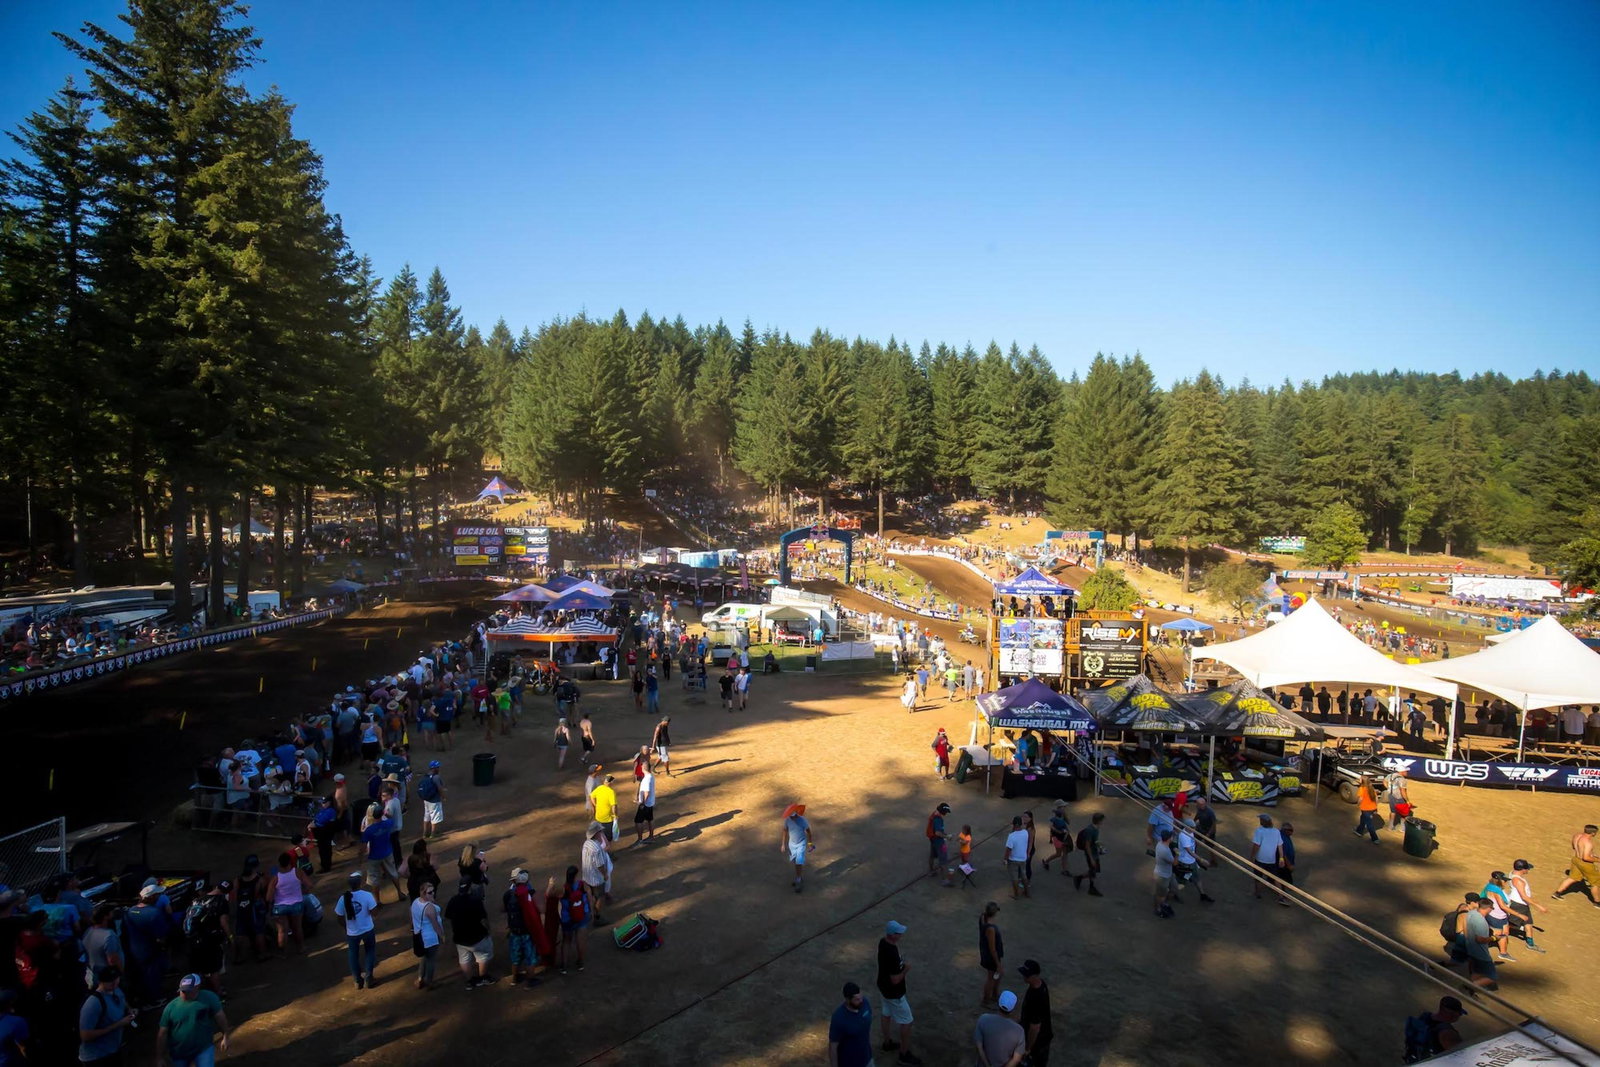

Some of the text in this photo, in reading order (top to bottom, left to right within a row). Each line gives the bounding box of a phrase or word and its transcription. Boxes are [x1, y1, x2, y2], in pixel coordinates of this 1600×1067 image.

[1131, 694, 1164, 706] MOTO
[1138, 700, 1171, 712] TEES
[1238, 698, 1271, 710] MOTO
[1246, 704, 1278, 715] TEES
[999, 718, 1090, 729] WASHOUGAL MX
[1382, 757, 1416, 768] LY
[1426, 758, 1488, 779] WPS
[1506, 766, 1559, 778] FLY
[1149, 777, 1182, 789] MOTO
[1227, 781, 1262, 793] MOTO
[1232, 789, 1264, 801] TEES
